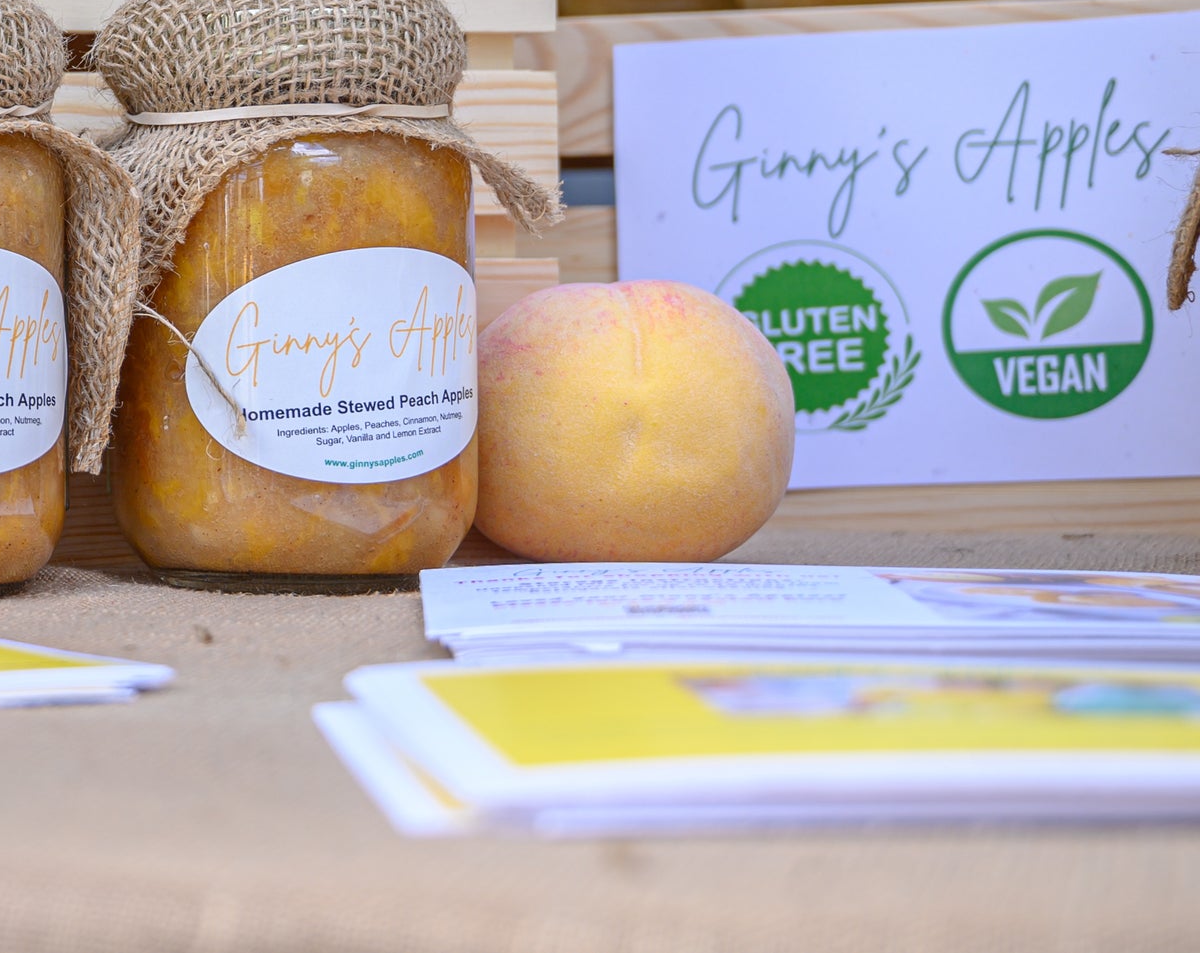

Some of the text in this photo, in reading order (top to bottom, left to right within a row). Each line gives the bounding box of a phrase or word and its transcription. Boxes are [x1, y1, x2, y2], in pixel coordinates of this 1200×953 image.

[692, 77, 1170, 237] Ginny's Apples
[225, 285, 474, 397] Ginny's Apples
[993, 353, 1108, 396] VEGAN
[18, 393, 56, 409] Apples
[338, 396, 395, 414] Stewed
[399, 390, 439, 408] Peach
[443, 386, 473, 408] Apples
[277, 425, 329, 437] Ingredients:
[331, 422, 362, 434] Apples,
[364, 418, 401, 429] Peaches,
[403, 414, 439, 426] Cinnamon,
[316, 425, 441, 446] Sugar, Vanilla and Lemon Extract
[324, 449, 424, 469] www.ginnysapples.com
